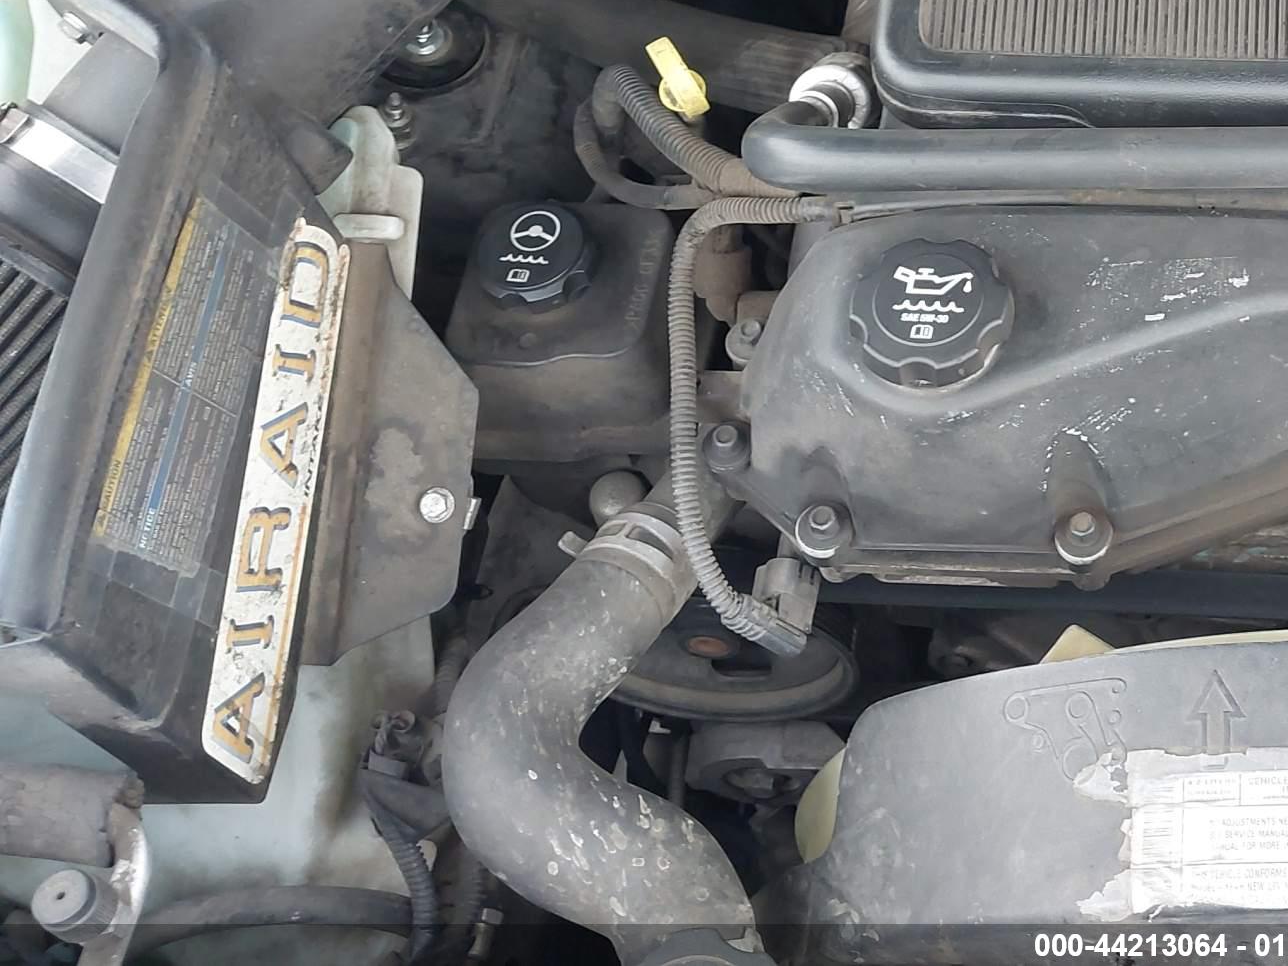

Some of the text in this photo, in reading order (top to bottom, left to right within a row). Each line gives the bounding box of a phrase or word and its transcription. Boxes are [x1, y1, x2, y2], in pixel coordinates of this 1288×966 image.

[900, 312, 920, 322] SAE
[99, 458, 122, 512] CAUTION
[210, 242, 331, 764] AIRAID
[138, 506, 157, 549] NOTICE
